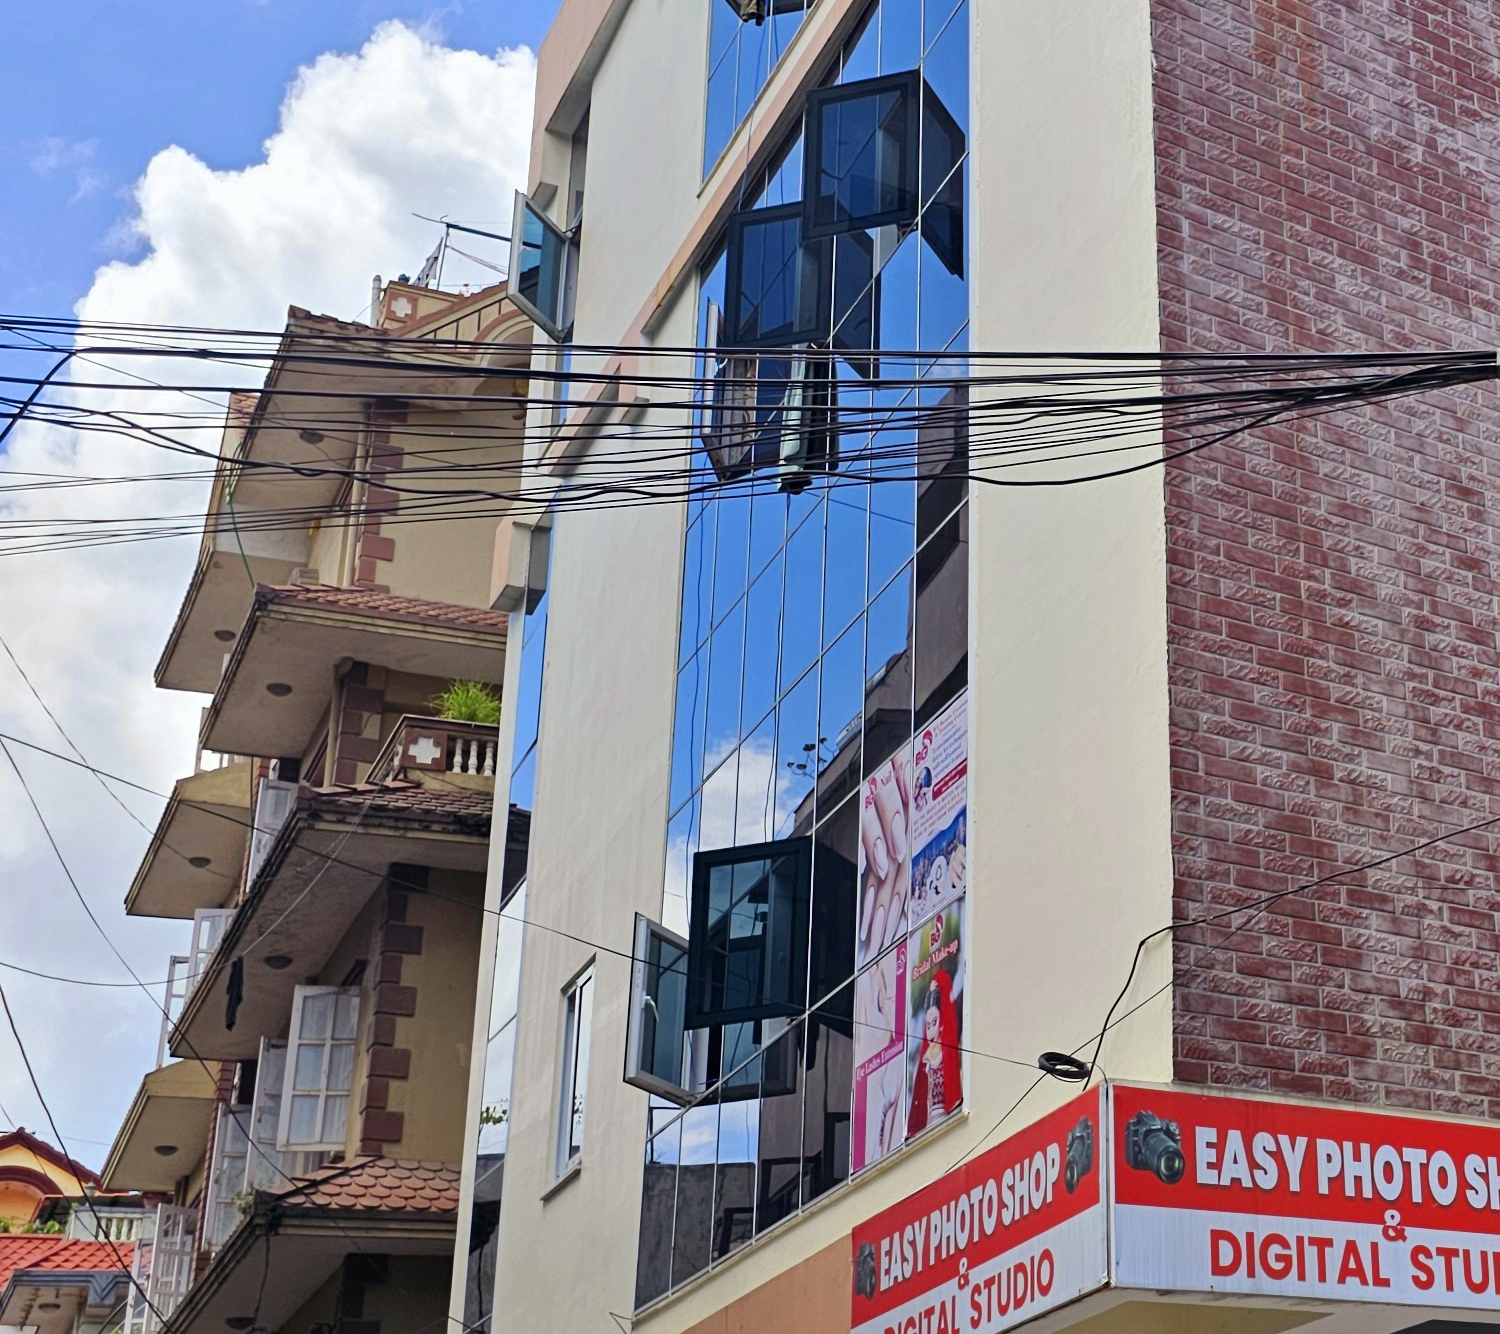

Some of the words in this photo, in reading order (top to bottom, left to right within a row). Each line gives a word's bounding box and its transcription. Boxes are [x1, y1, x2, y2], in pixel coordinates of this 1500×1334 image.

[1195, 1126, 1308, 1192] EASY
[1316, 1138, 1457, 1205] PHOTO
[880, 1216, 927, 1292] EASY
[930, 1179, 998, 1266] PHOTO
[1002, 1143, 1060, 1226] SHOP
[1381, 1209, 1407, 1242] &
[958, 1257, 970, 1290] &
[970, 1248, 1054, 1329] STUDIO
[1210, 1229, 1391, 1287] DIGITAL
